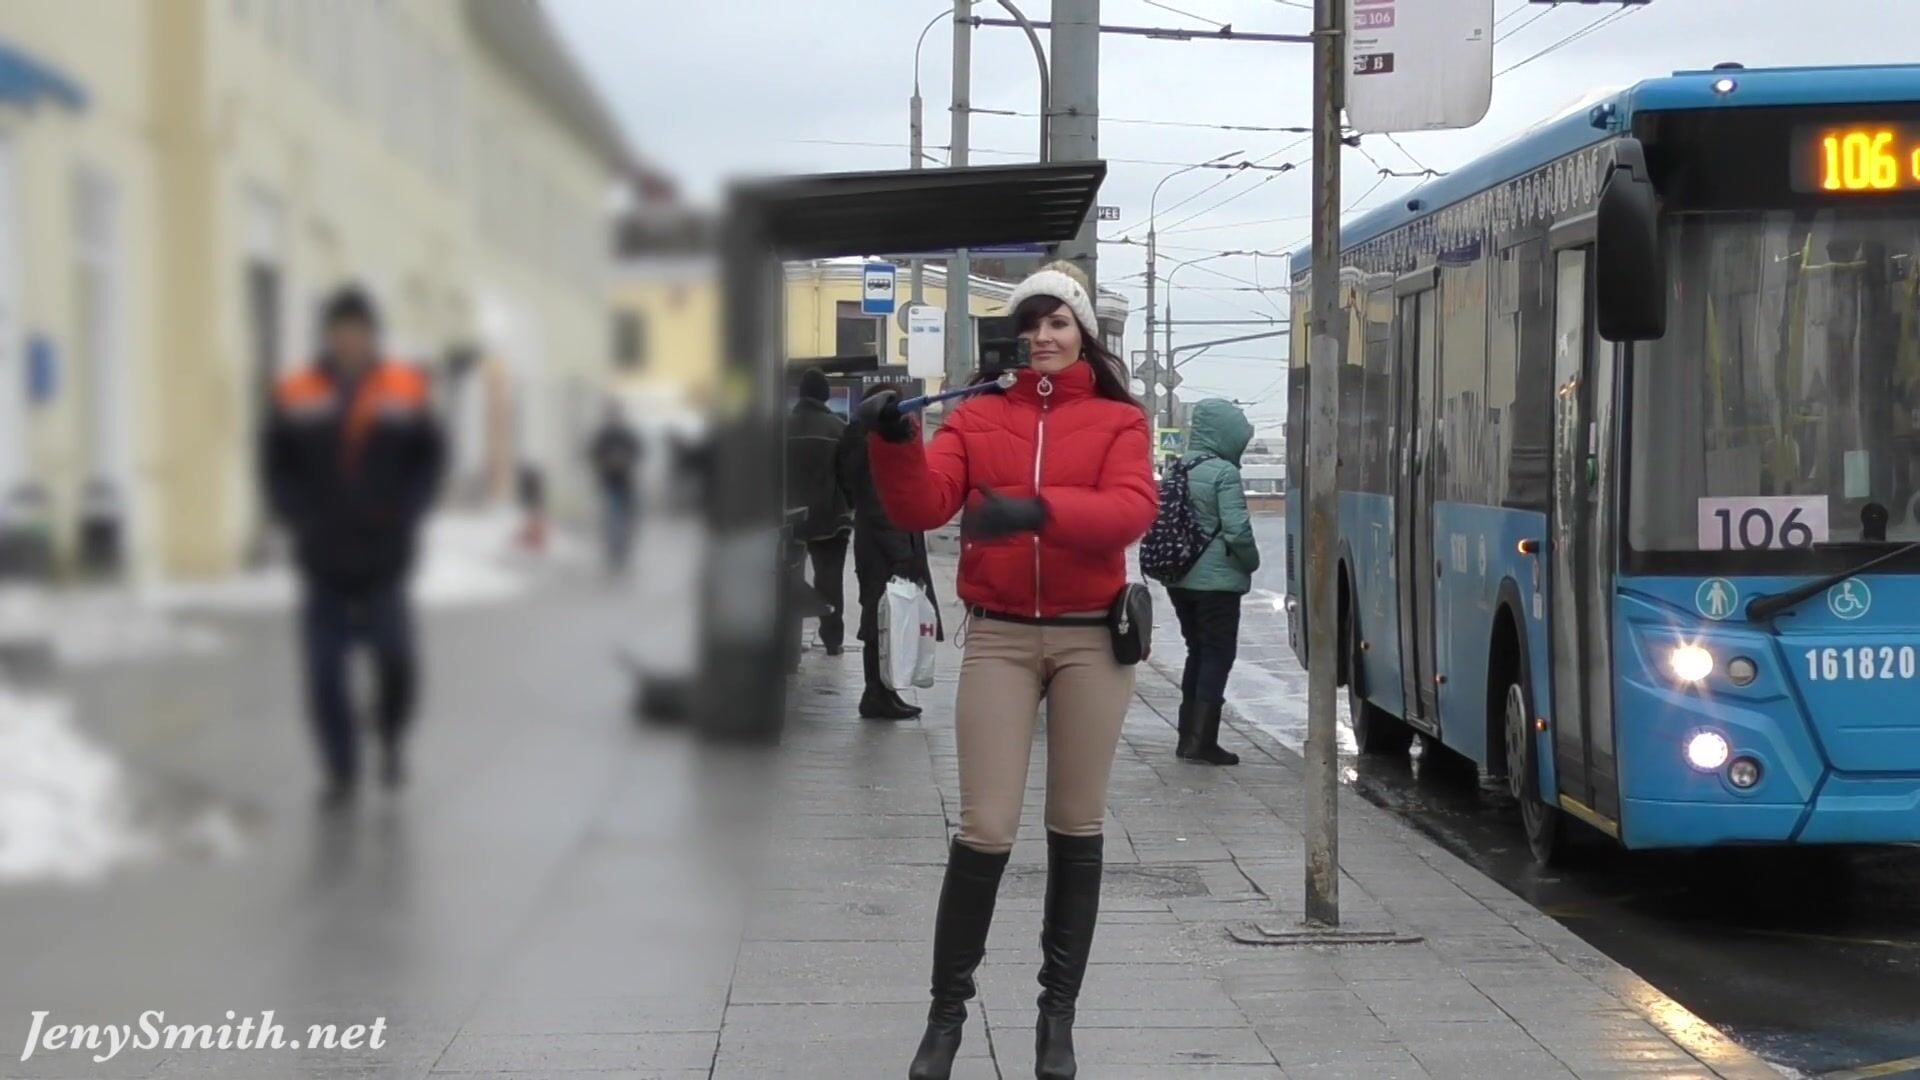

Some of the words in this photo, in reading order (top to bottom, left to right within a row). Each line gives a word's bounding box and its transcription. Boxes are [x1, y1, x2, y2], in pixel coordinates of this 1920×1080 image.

[1370, 12, 1391, 25] 106
[1823, 132, 1897, 190] 106
[1714, 508, 1813, 550] 106
[1805, 646, 1915, 681] 161820
